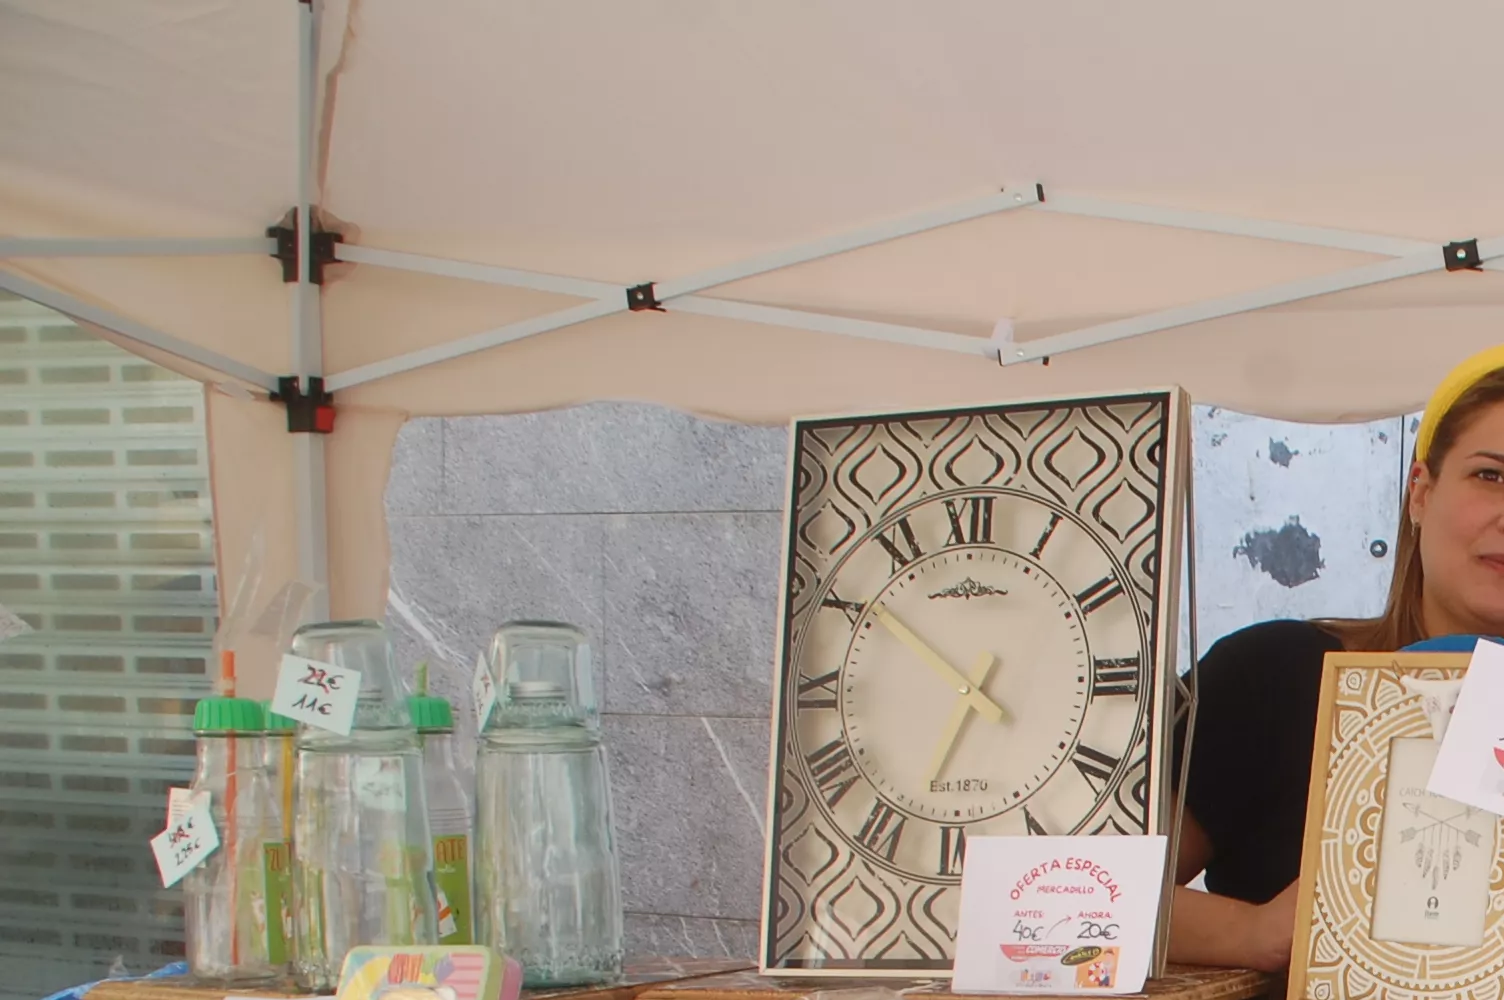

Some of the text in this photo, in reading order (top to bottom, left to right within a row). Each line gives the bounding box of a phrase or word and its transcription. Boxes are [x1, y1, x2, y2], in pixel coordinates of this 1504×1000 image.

[1010, 857, 1123, 903] OFERTA ESPECIAL
[1036, 885, 1095, 895] MERCADILLO
[1012, 920, 1120, 941] 40€ 20€
